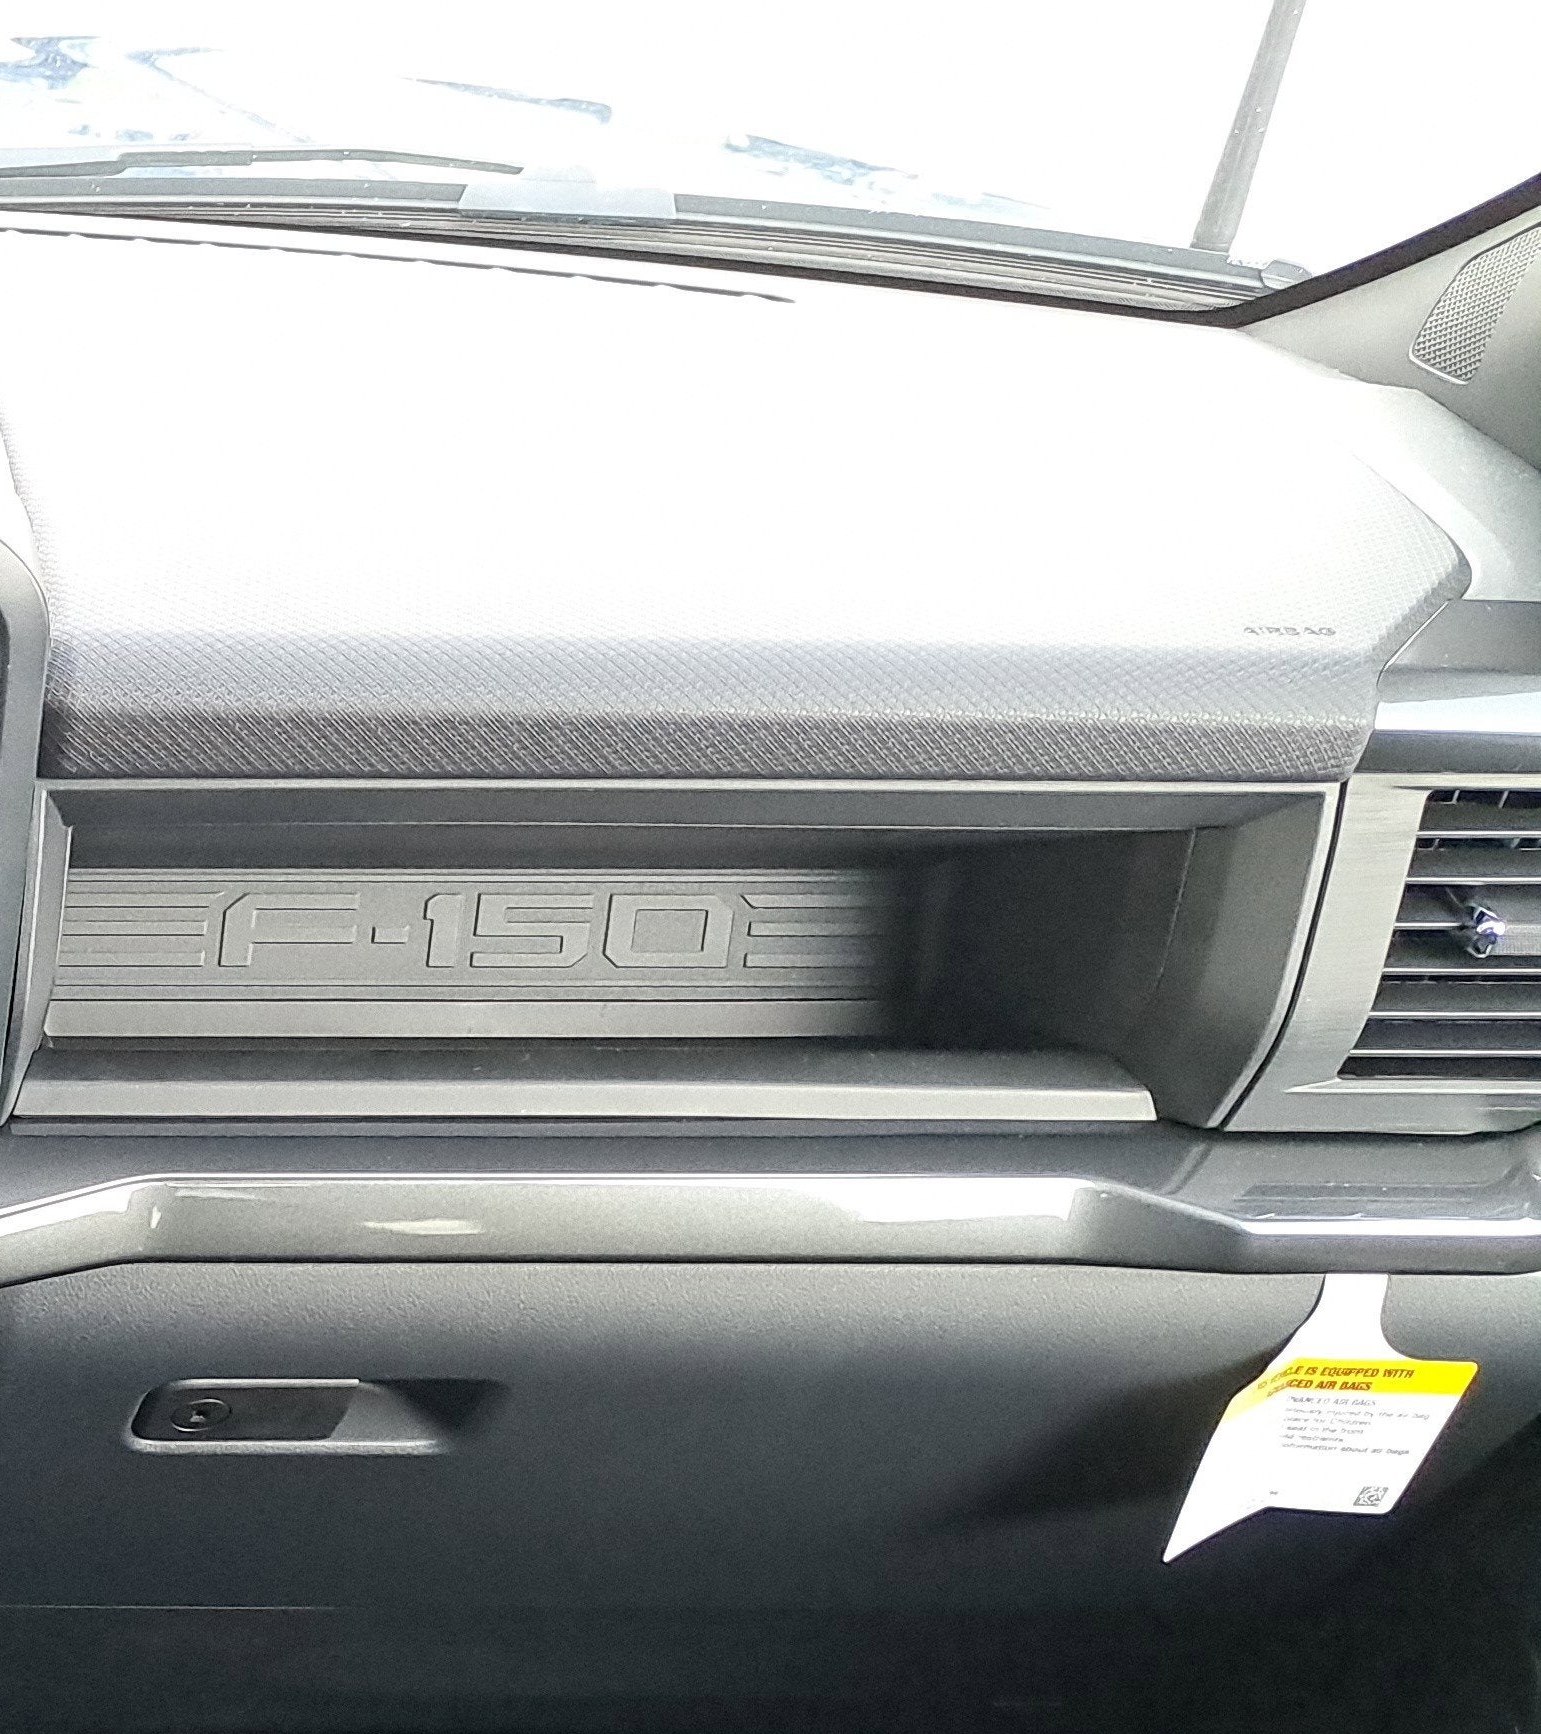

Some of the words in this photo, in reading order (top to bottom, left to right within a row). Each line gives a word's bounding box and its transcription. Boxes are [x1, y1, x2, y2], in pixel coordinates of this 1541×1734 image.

[218, 892, 734, 969] F-150
[1320, 1367, 1379, 1379] EQUIPPED
[1383, 1368, 1415, 1379] WITH
[1315, 1380, 1337, 1391] AIR
[1339, 1380, 1372, 1391] BAGS
